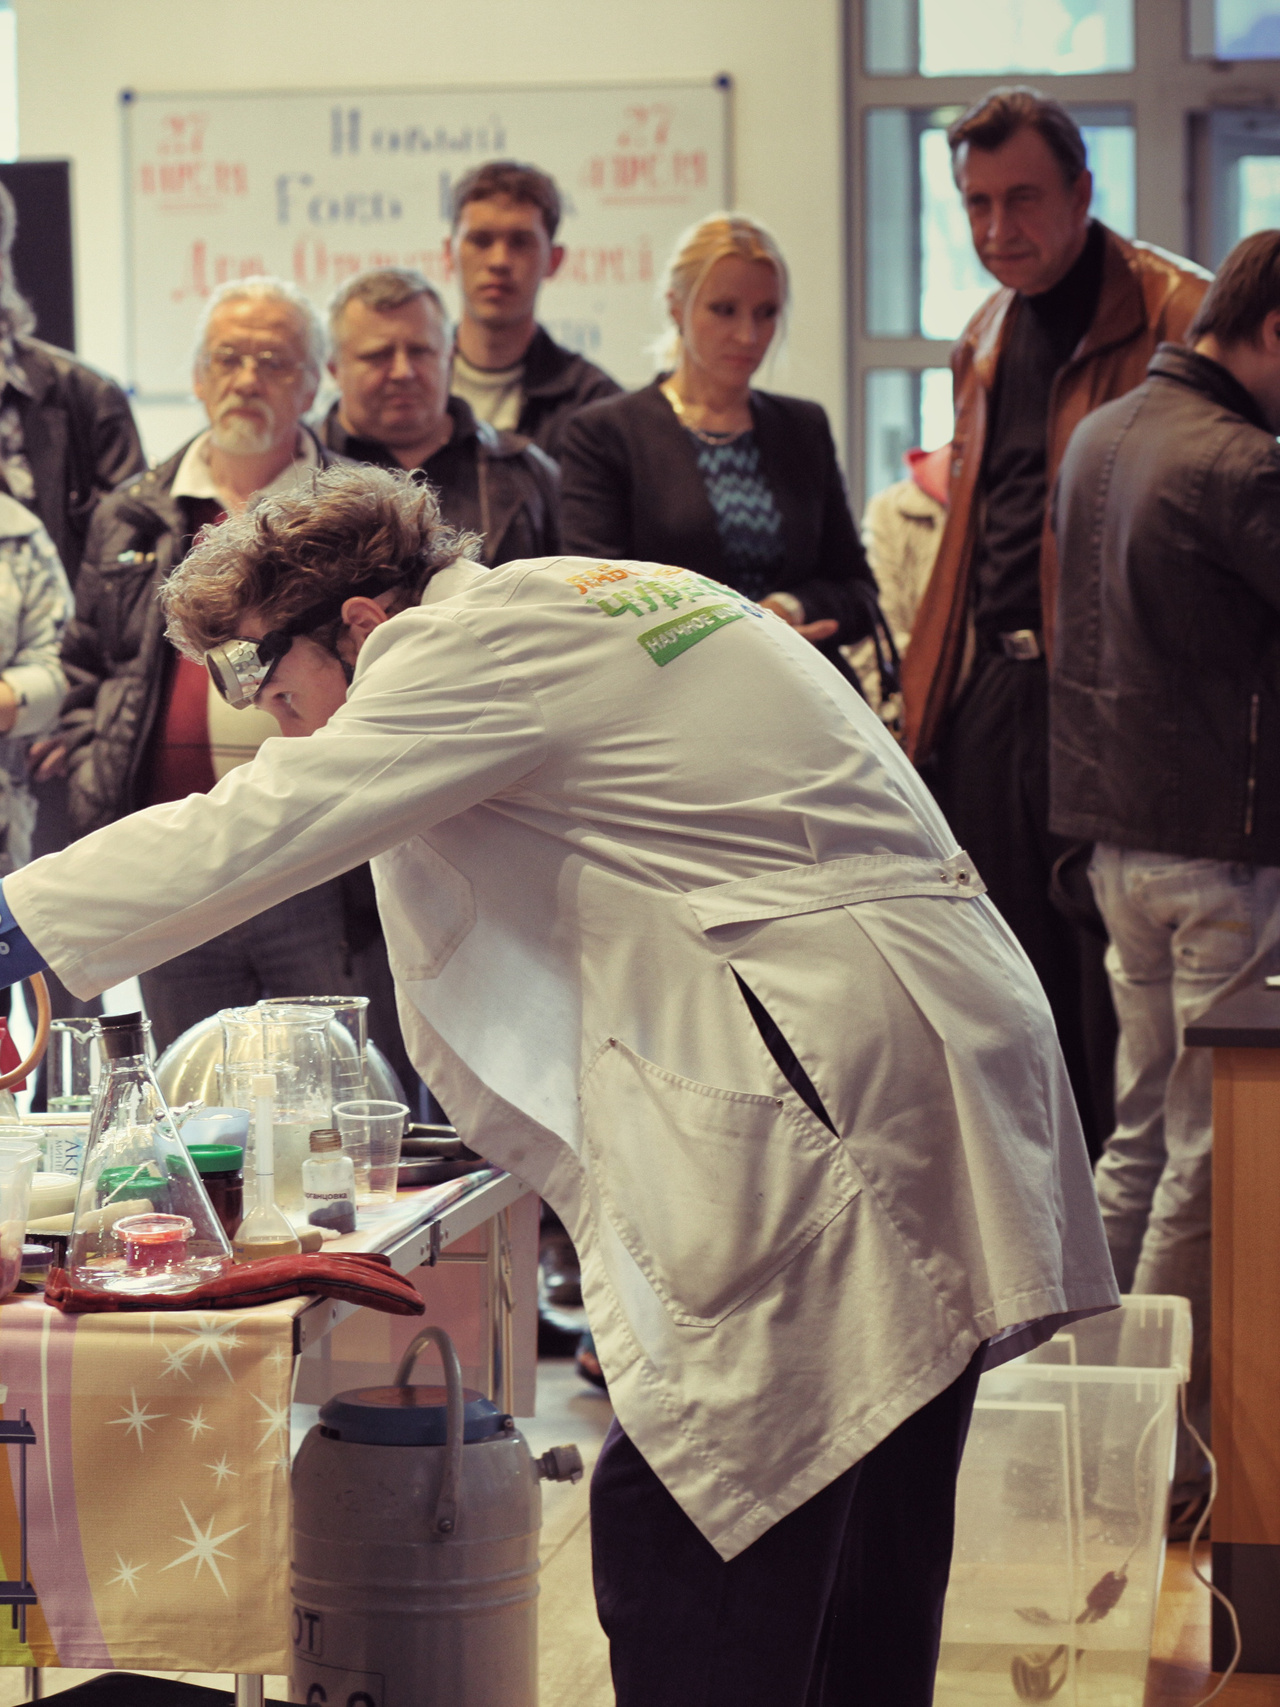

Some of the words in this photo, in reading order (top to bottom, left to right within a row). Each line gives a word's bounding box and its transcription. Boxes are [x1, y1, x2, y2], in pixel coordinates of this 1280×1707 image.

[645, 613, 716, 655] НАУЧНОЕ
[63, 1140, 80, 1175] АКВ
[304, 1191, 348, 1202] рганцовка
